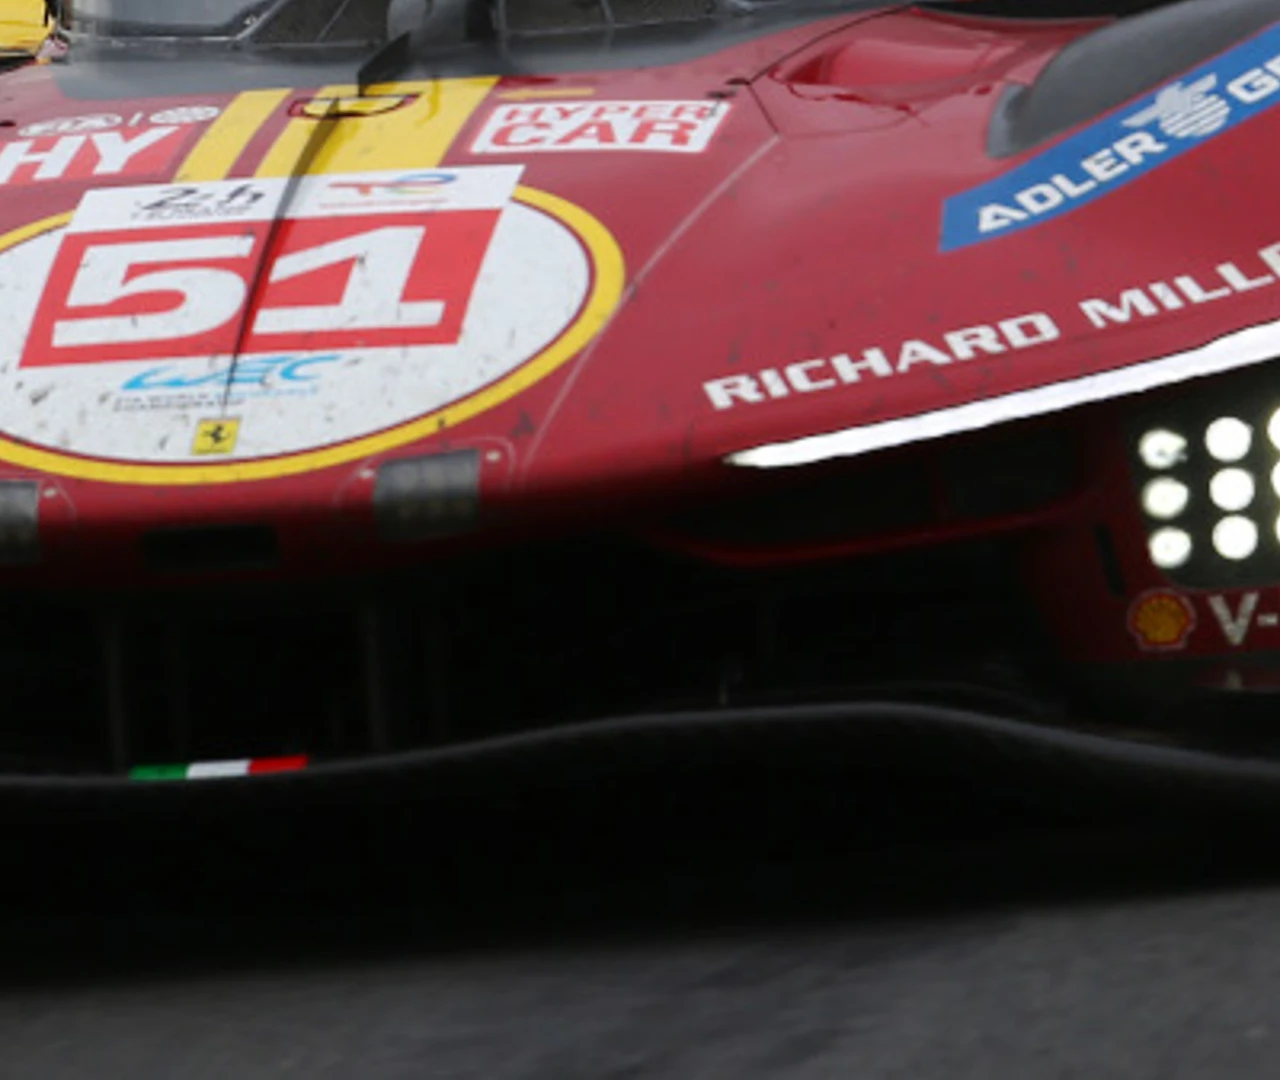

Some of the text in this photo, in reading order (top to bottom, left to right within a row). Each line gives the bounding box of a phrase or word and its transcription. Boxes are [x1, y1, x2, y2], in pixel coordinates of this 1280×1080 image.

[491, 119, 701, 148] CAR
[502, 102, 710, 123] HYPER
[976, 130, 1167, 232] ADLER
[50, 224, 444, 348] 51
[120, 353, 343, 391] WEC
[701, 312, 1061, 411] RICHARD
